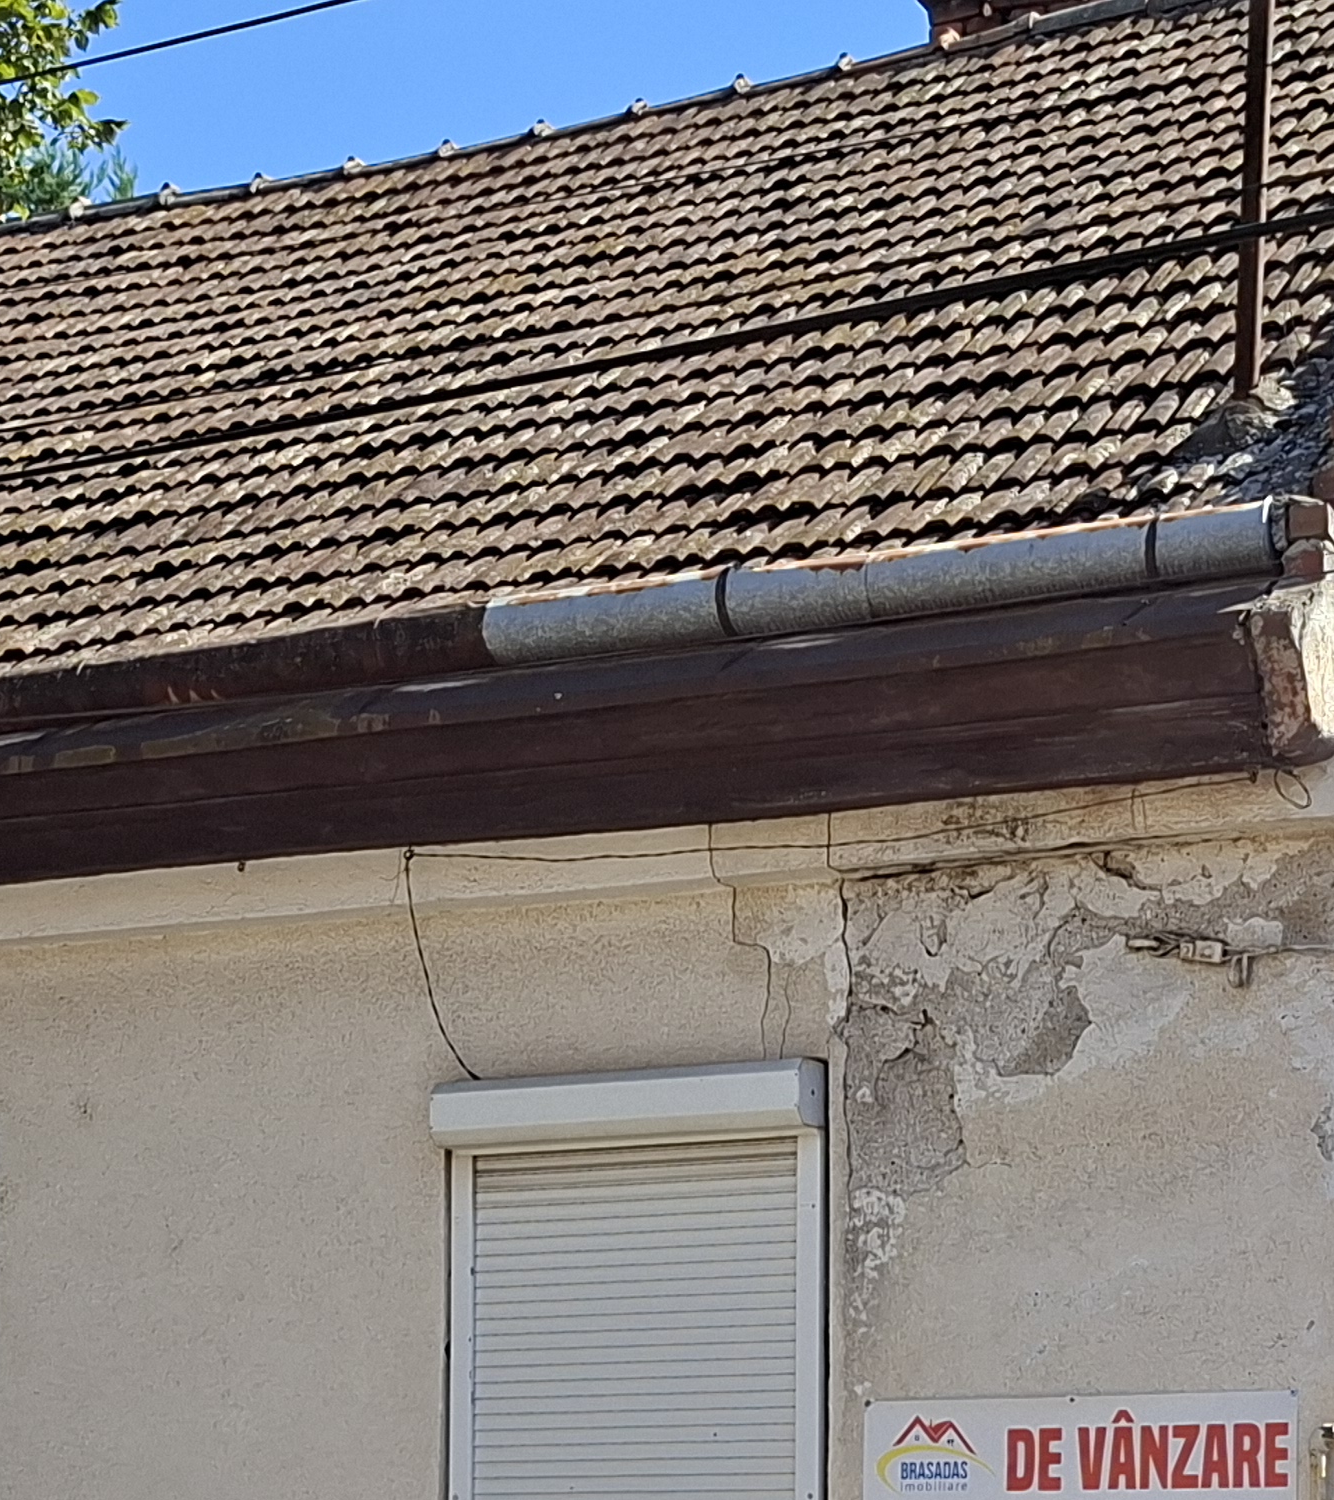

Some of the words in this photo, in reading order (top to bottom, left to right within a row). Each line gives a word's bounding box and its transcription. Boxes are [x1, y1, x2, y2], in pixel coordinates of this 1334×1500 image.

[900, 1461, 968, 1480] BRASADAS
[1006, 1428, 1062, 1491] DE
[1077, 1409, 1290, 1490] VÂNZARE
